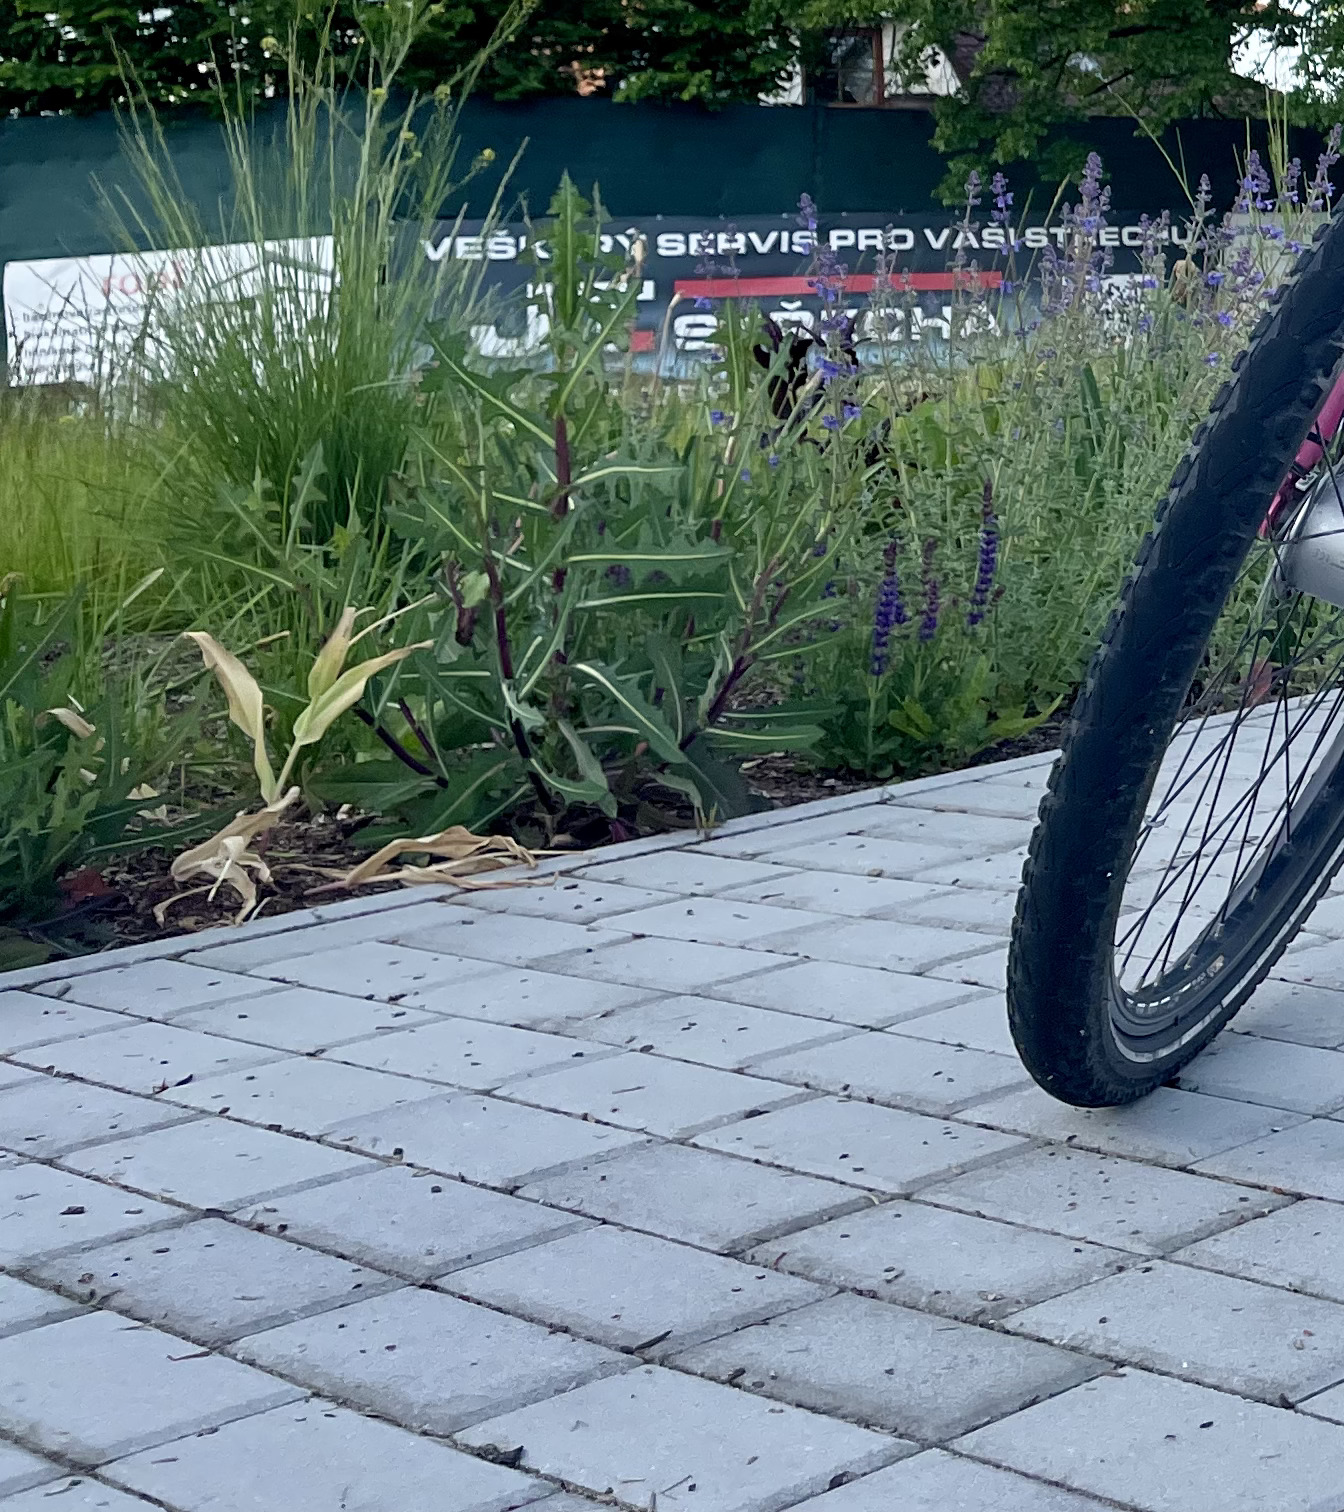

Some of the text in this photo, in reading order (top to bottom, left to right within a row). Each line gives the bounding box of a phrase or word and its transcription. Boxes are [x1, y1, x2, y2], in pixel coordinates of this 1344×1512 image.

[656, 228, 818, 257] SERVIS
[828, 227, 914, 252] PRO
[923, 220, 1016, 251] VAŠI
[1024, 224, 1194, 249] STECU
